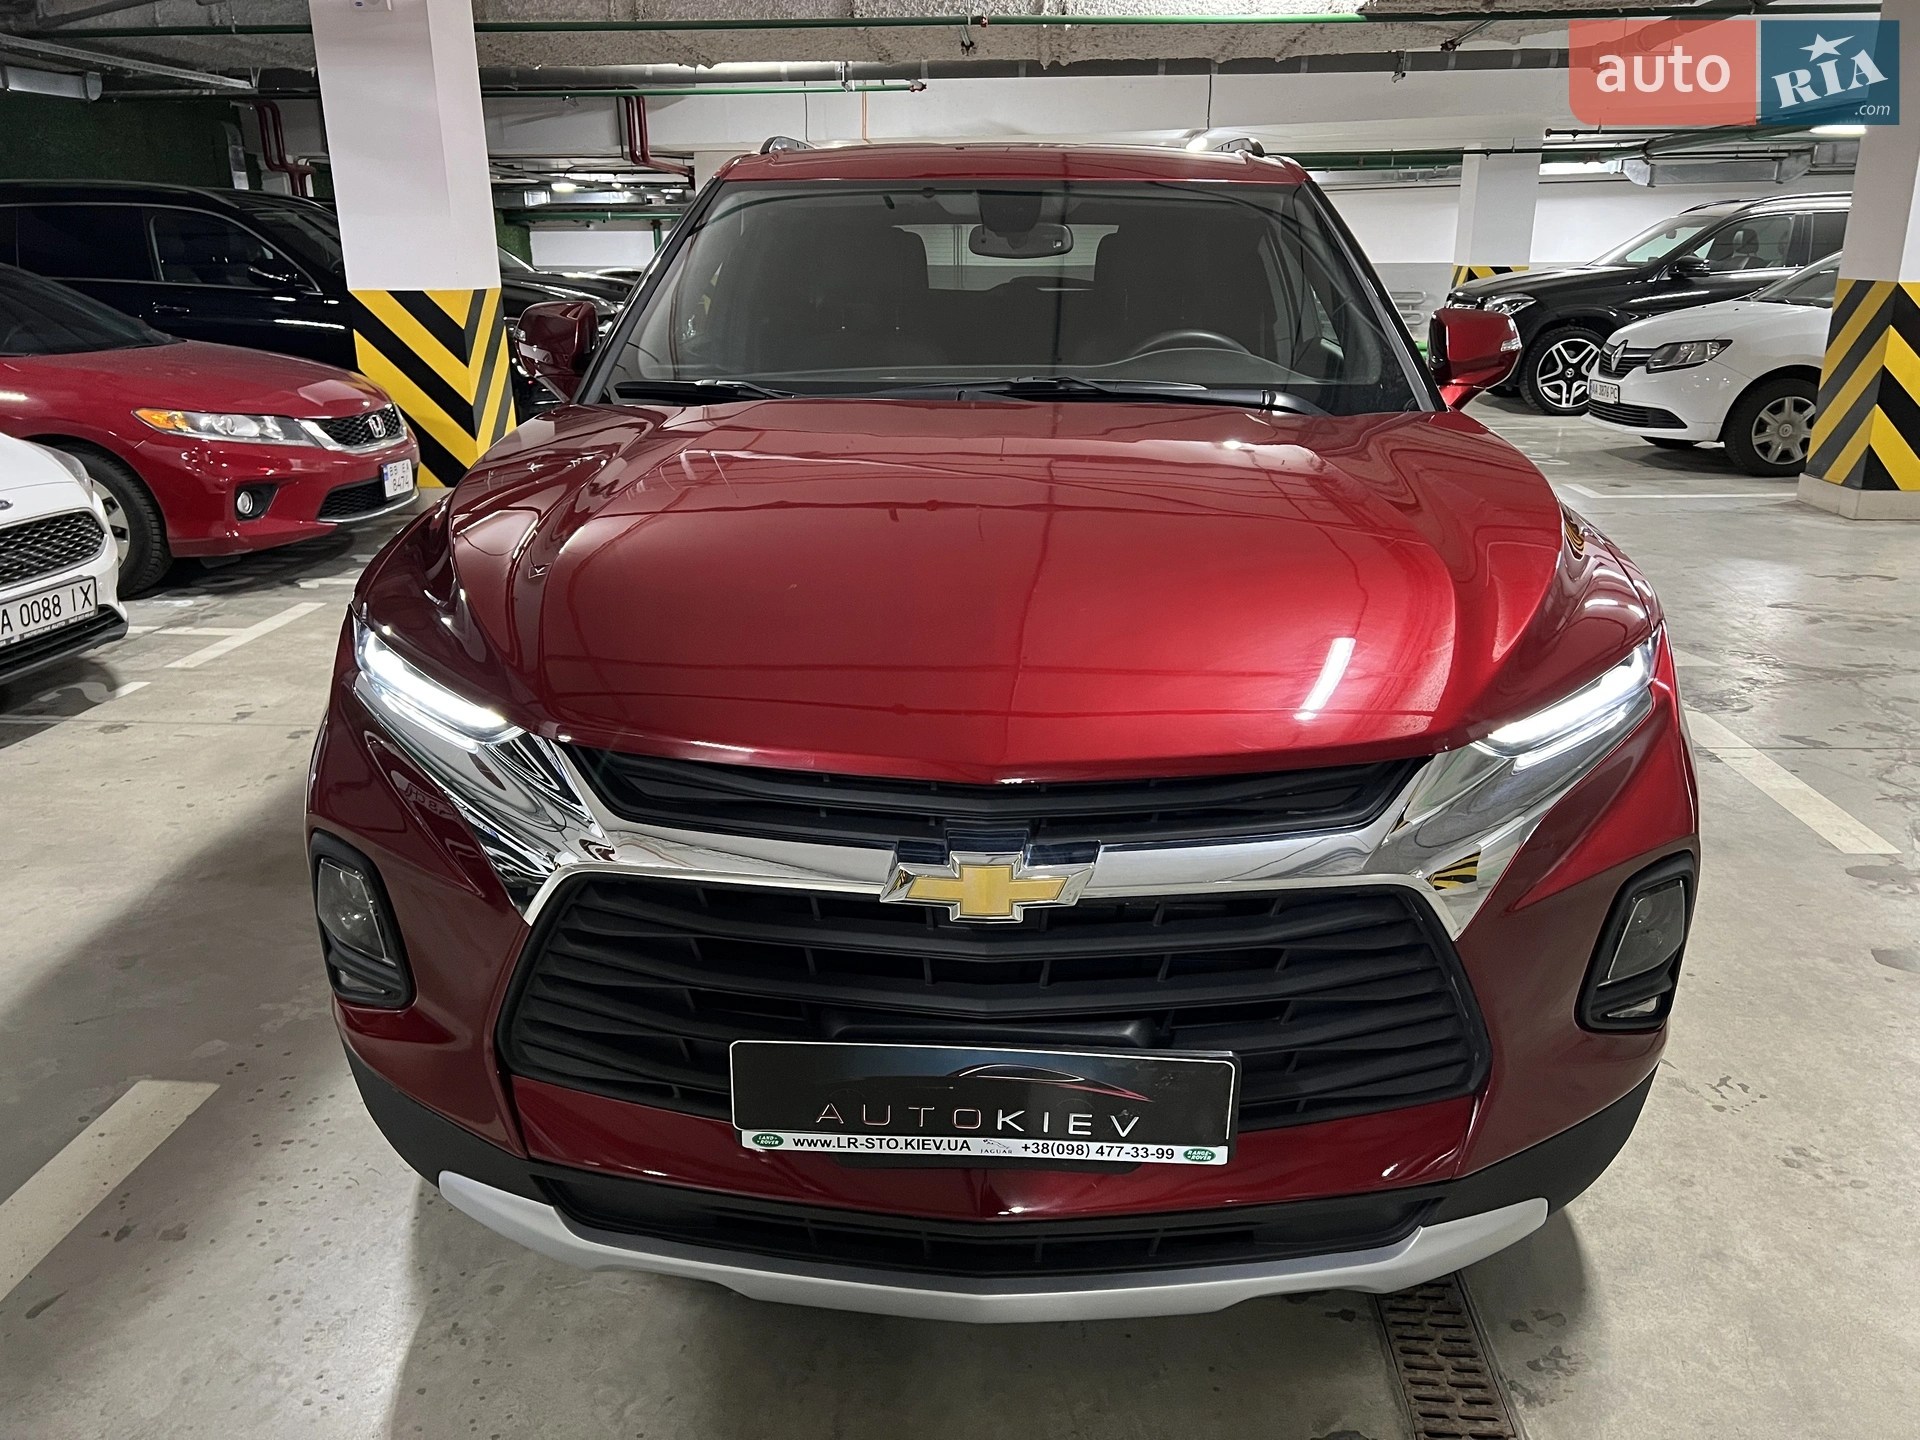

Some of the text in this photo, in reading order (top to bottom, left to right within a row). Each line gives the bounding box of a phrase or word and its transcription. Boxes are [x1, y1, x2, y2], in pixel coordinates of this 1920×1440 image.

[20, 594, 61, 627] 0088
[792, 1136, 972, 1152] www.LR-STO.KIEV.UA
[1021, 1142, 1175, 1160] +38(098) 477-33-99
